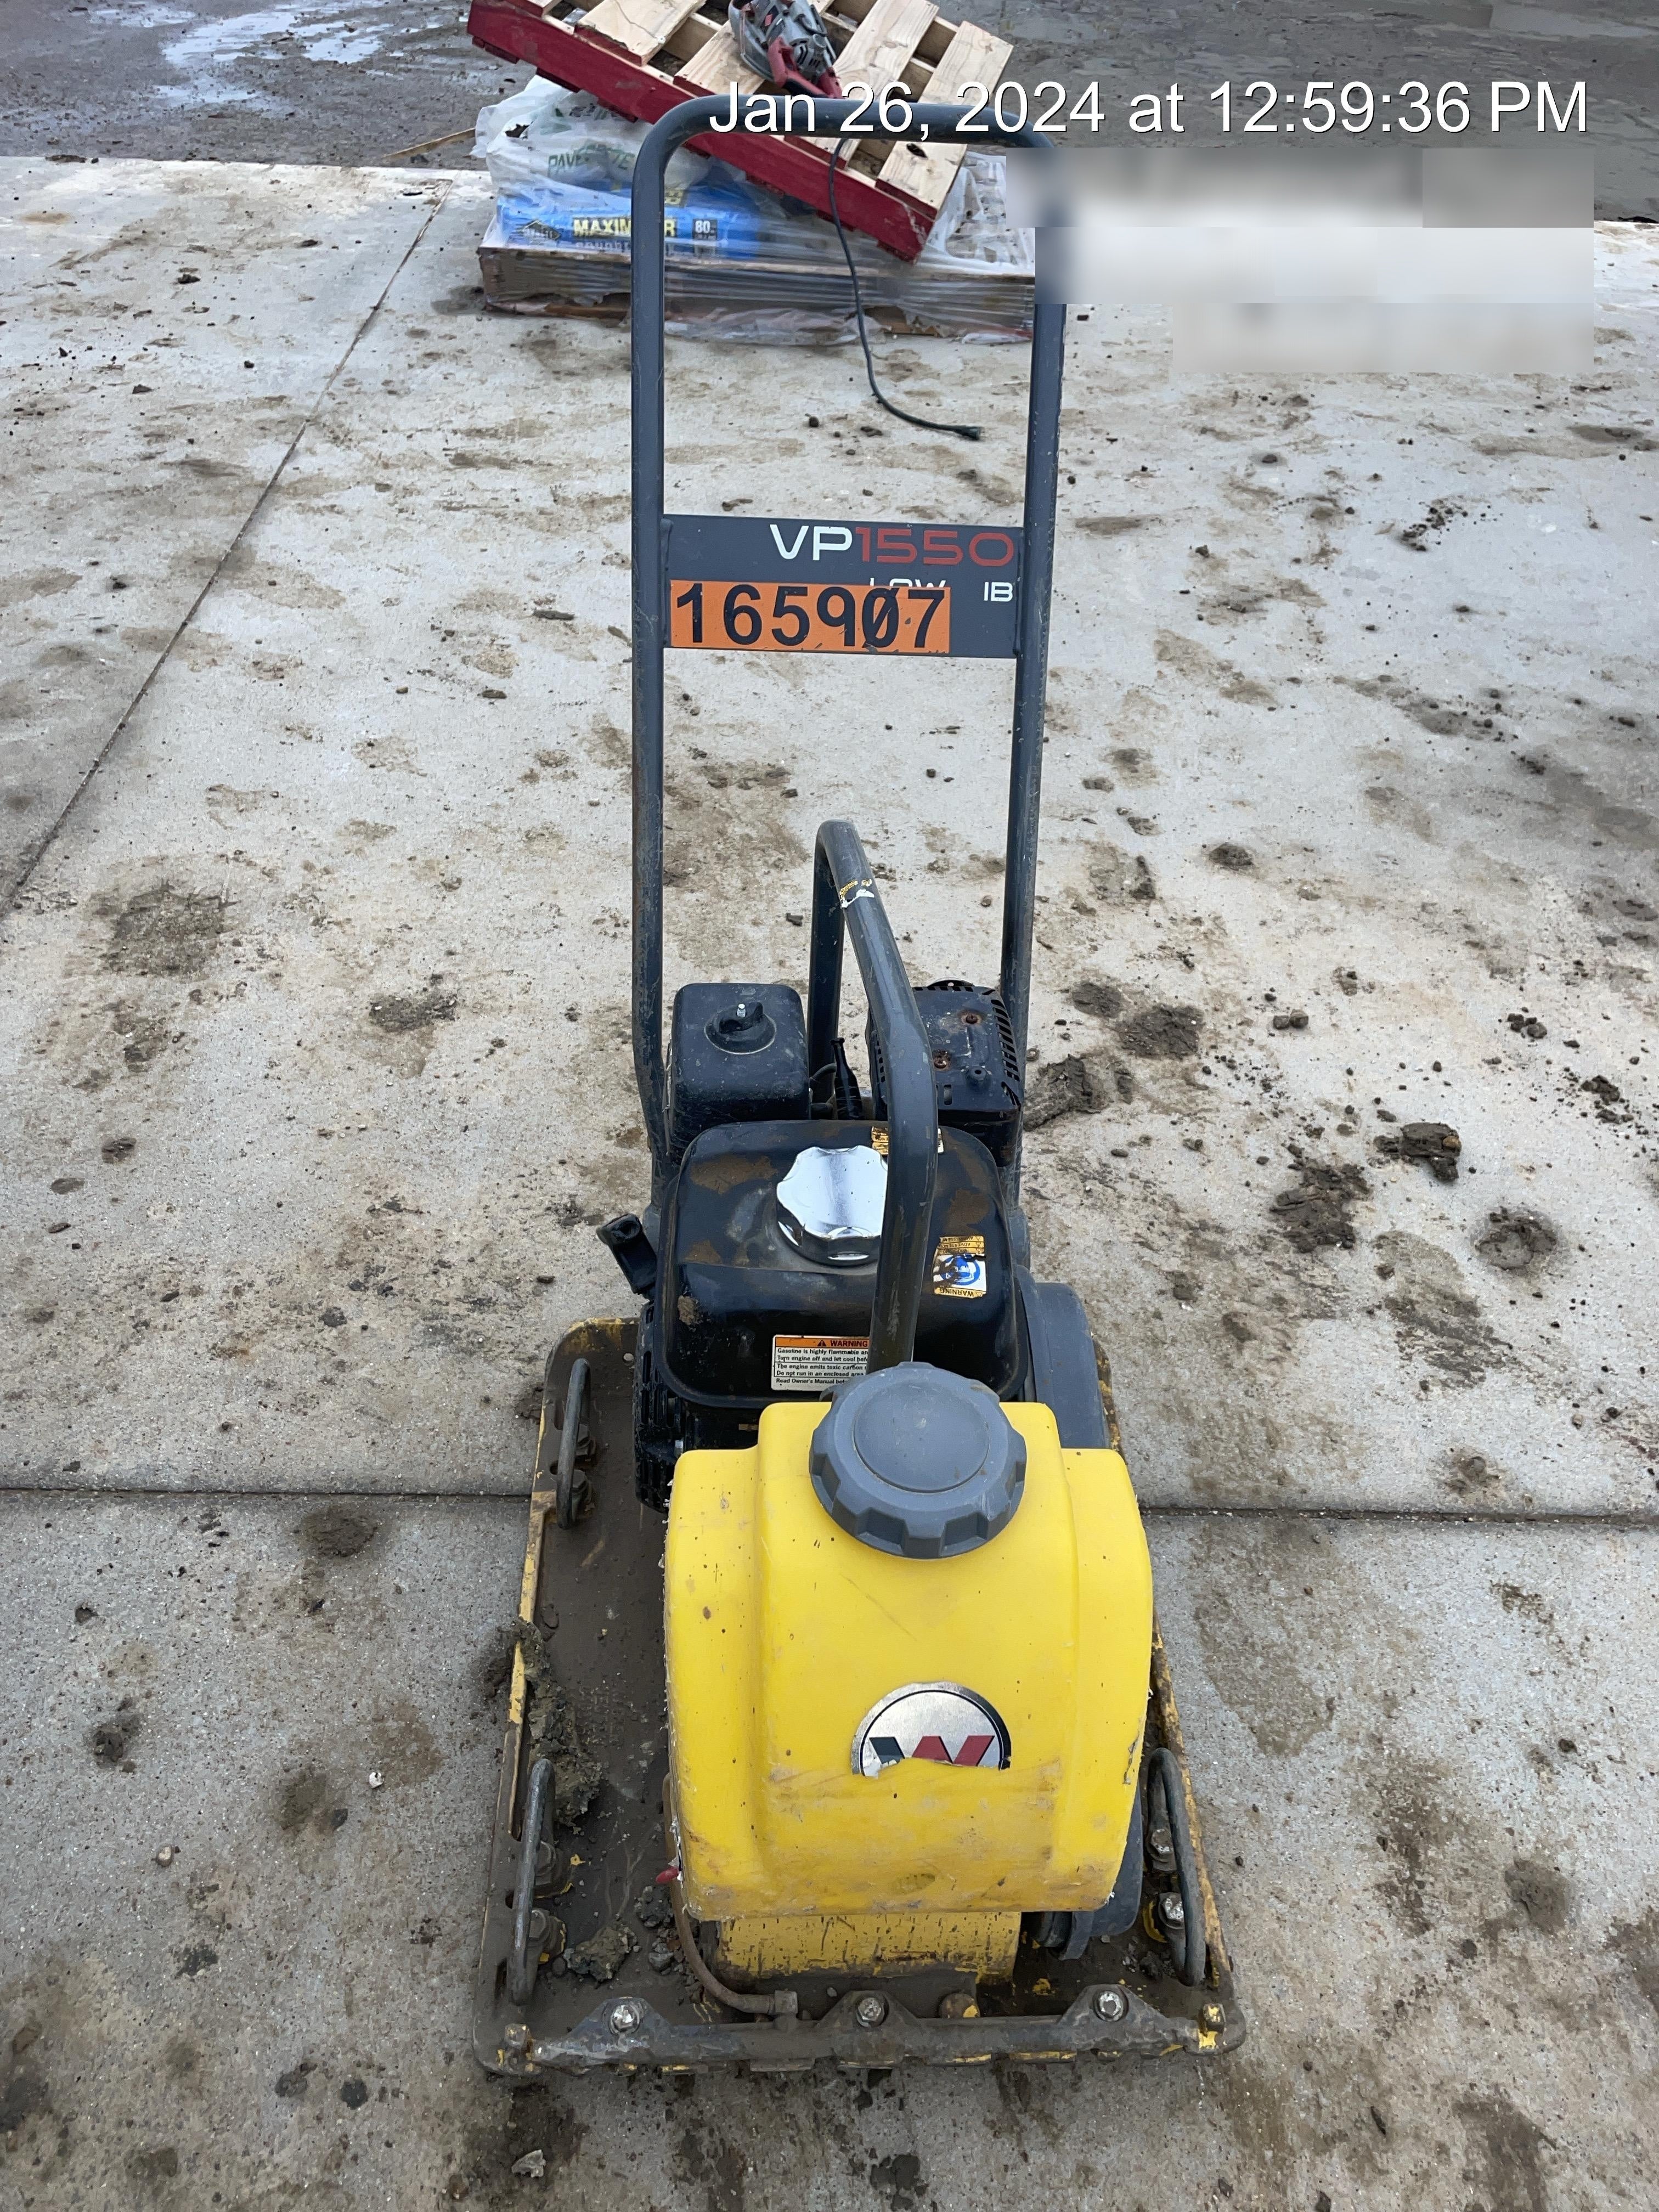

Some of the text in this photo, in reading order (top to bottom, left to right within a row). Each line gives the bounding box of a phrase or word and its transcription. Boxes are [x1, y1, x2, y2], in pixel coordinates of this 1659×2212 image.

[573, 218, 676, 238] MAXIMR
[695, 220, 711, 234] 80
[770, 524, 1014, 566] VP1550
[676, 583, 945, 649] 165907
[939, 1287, 974, 1297] WARNING
